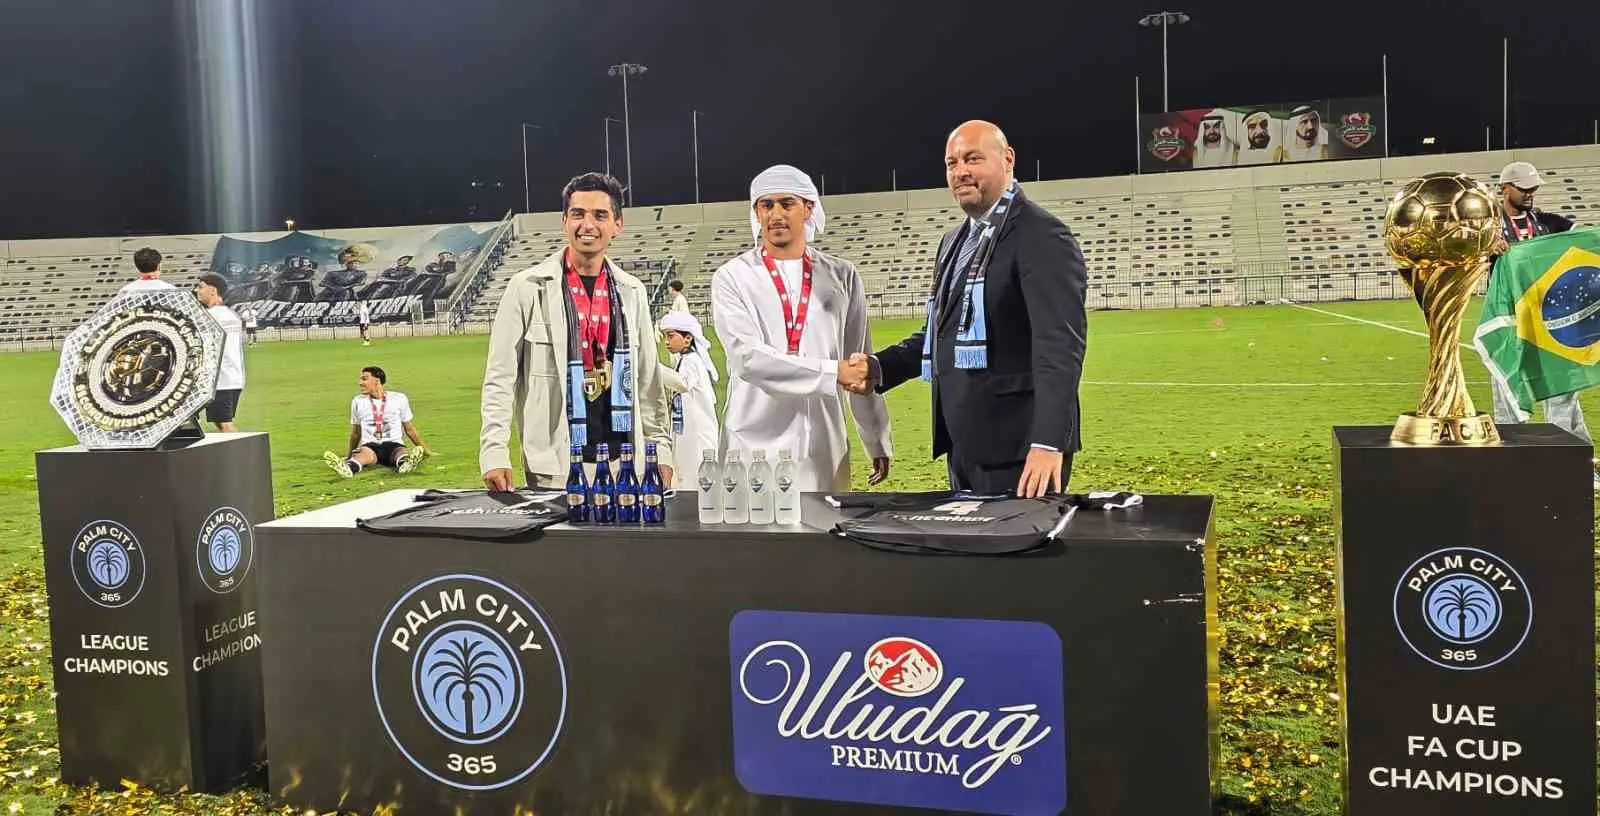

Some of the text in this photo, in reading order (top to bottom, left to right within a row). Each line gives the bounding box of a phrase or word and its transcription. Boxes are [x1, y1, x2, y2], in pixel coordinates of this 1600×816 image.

[653, 207, 664, 221] 7
[102, 412, 156, 428] DIVISION
[1430, 422, 1455, 440] FA
[78, 525, 137, 553] PALM CITY
[202, 512, 247, 545] PALM CITY
[219, 576, 234, 588] 365
[1408, 555, 1516, 592] PALM CITY
[100, 592, 121, 602] 365
[205, 611, 256, 642] LEAGUE
[391, 588, 543, 652] PALM CITY
[81, 634, 149, 651] LEAGUE
[192, 633, 262, 672] CHAMPION
[64, 657, 169, 676] CHAMPIONS
[1441, 649, 1477, 661] 365
[1431, 703, 1496, 727] UAE
[1407, 735, 1523, 761] FA CUP
[447, 753, 497, 775] 365
[831, 745, 960, 776] PREMIUM
[1368, 766, 1564, 799] CHAMPIONS
